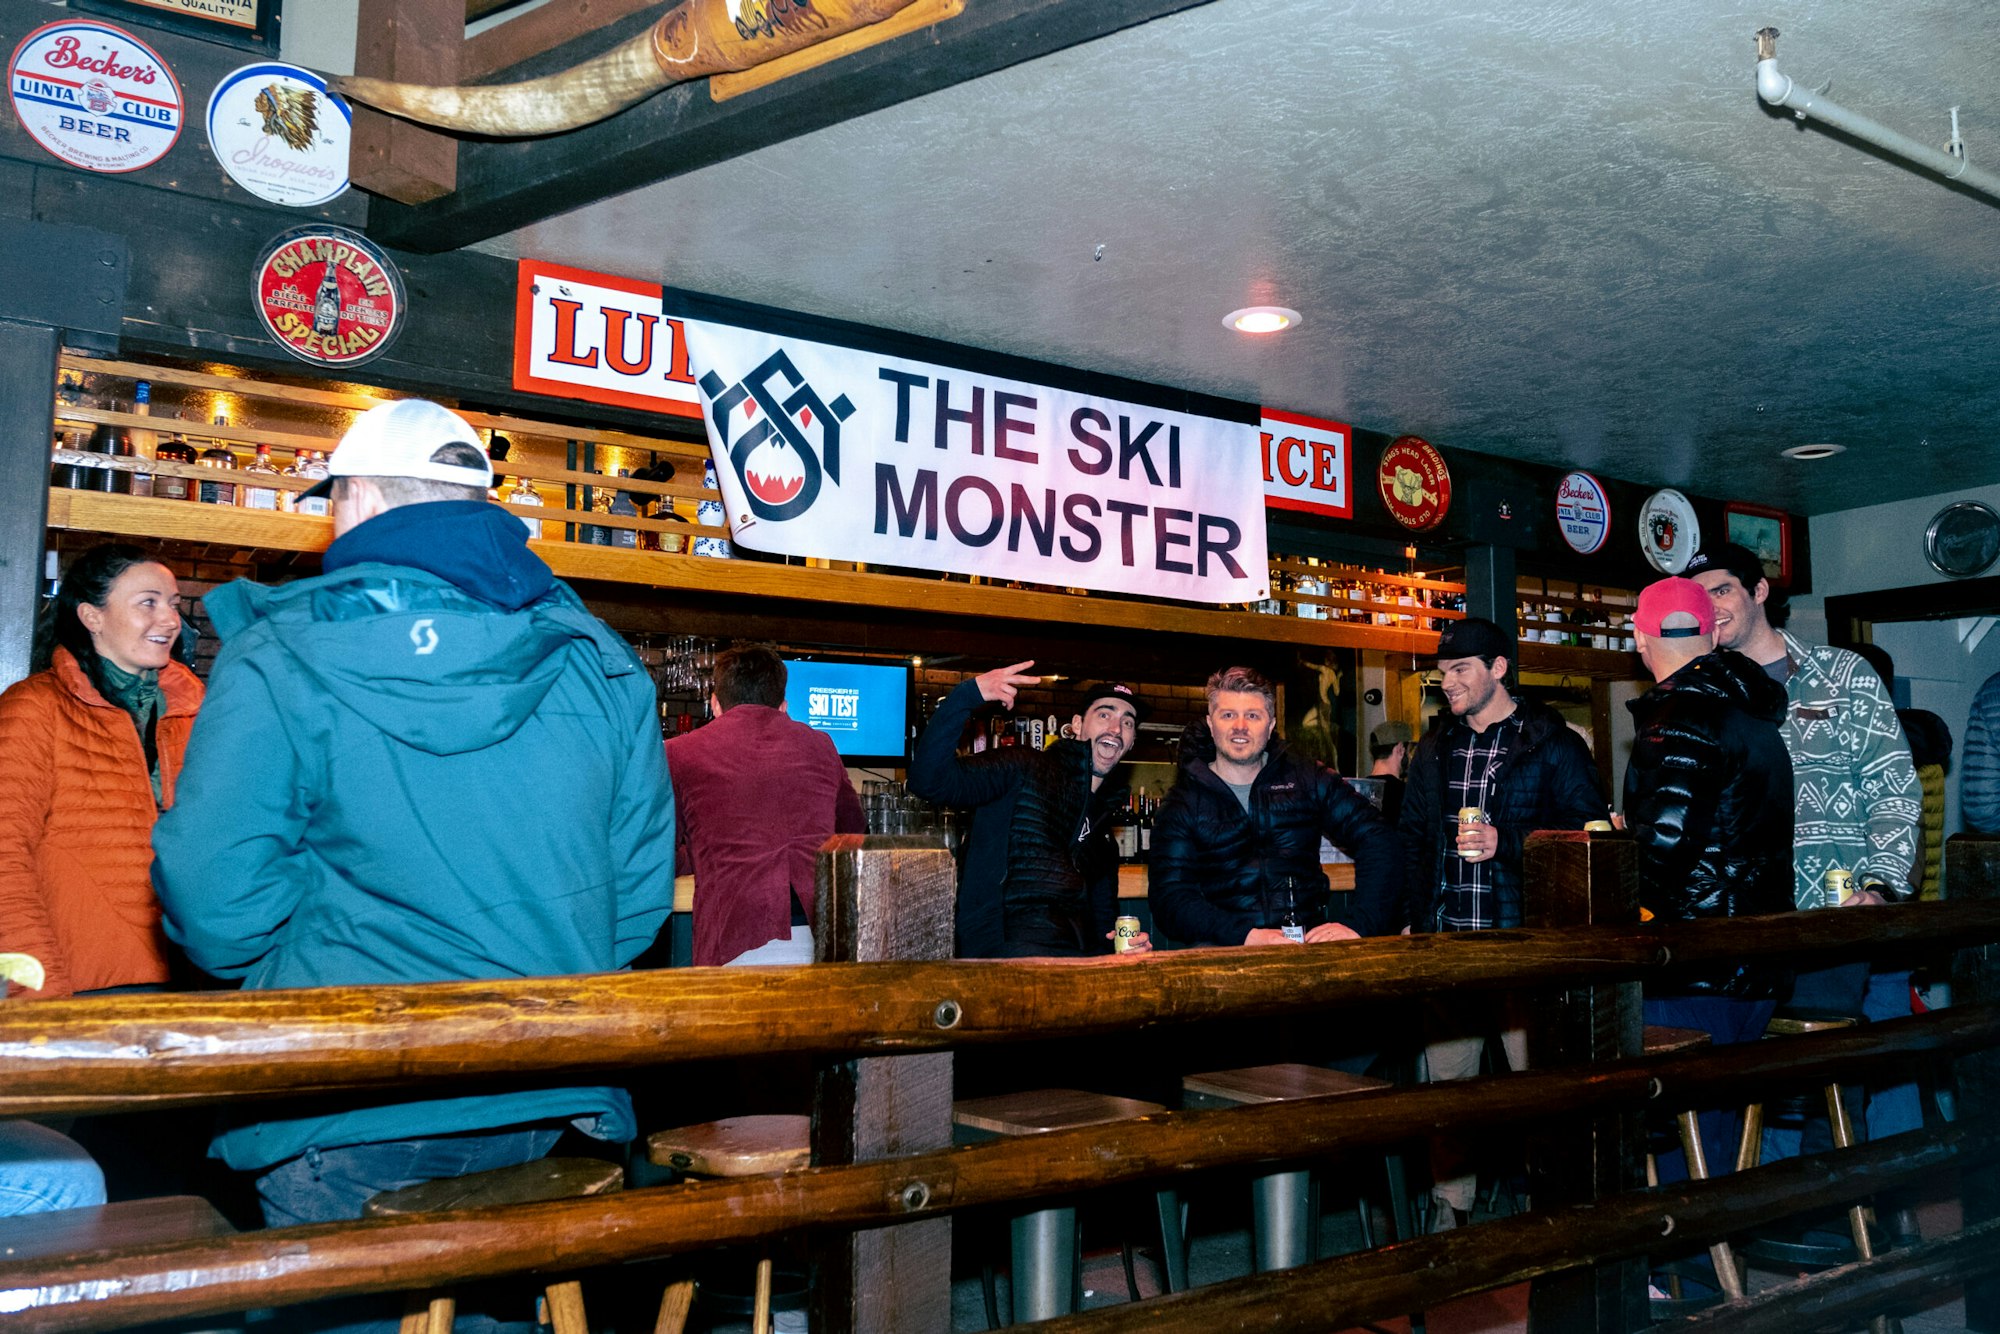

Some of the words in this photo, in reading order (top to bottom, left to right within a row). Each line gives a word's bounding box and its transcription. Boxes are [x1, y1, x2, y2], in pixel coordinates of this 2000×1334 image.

[182, 0, 236, 16] QUALITY
[45, 36, 156, 84] Becker's
[20, 79, 74, 101] UINTA
[122, 102, 171, 122] CLUB
[59, 115, 131, 144] BEER
[41, 126, 66, 148] BECKER
[68, 146, 103, 162] BREWING
[112, 150, 140, 162] MALTING
[232, 136, 336, 180] Iroquois
[272, 240, 389, 297] CHAMPLAIN
[282, 283, 298, 292] LA
[266, 298, 314, 314] PARFAITE
[341, 310, 355, 320] DU
[879, 367, 1039, 465] THE
[1067, 406, 1182, 489] SKI
[1402, 447, 1420, 460] HEAD
[1420, 458, 1436, 486] LAGER
[1560, 480, 1594, 500] Becker's
[874, 462, 1249, 579] MONSTER
[1419, 510, 1430, 522] OLD
[1585, 512, 1600, 520] CLUB
[1567, 524, 1590, 534] BEER
[1656, 524, 1663, 536] G
[1664, 534, 1670, 545] B
[808, 694, 829, 717] SKI
[830, 694, 860, 718] TEST
